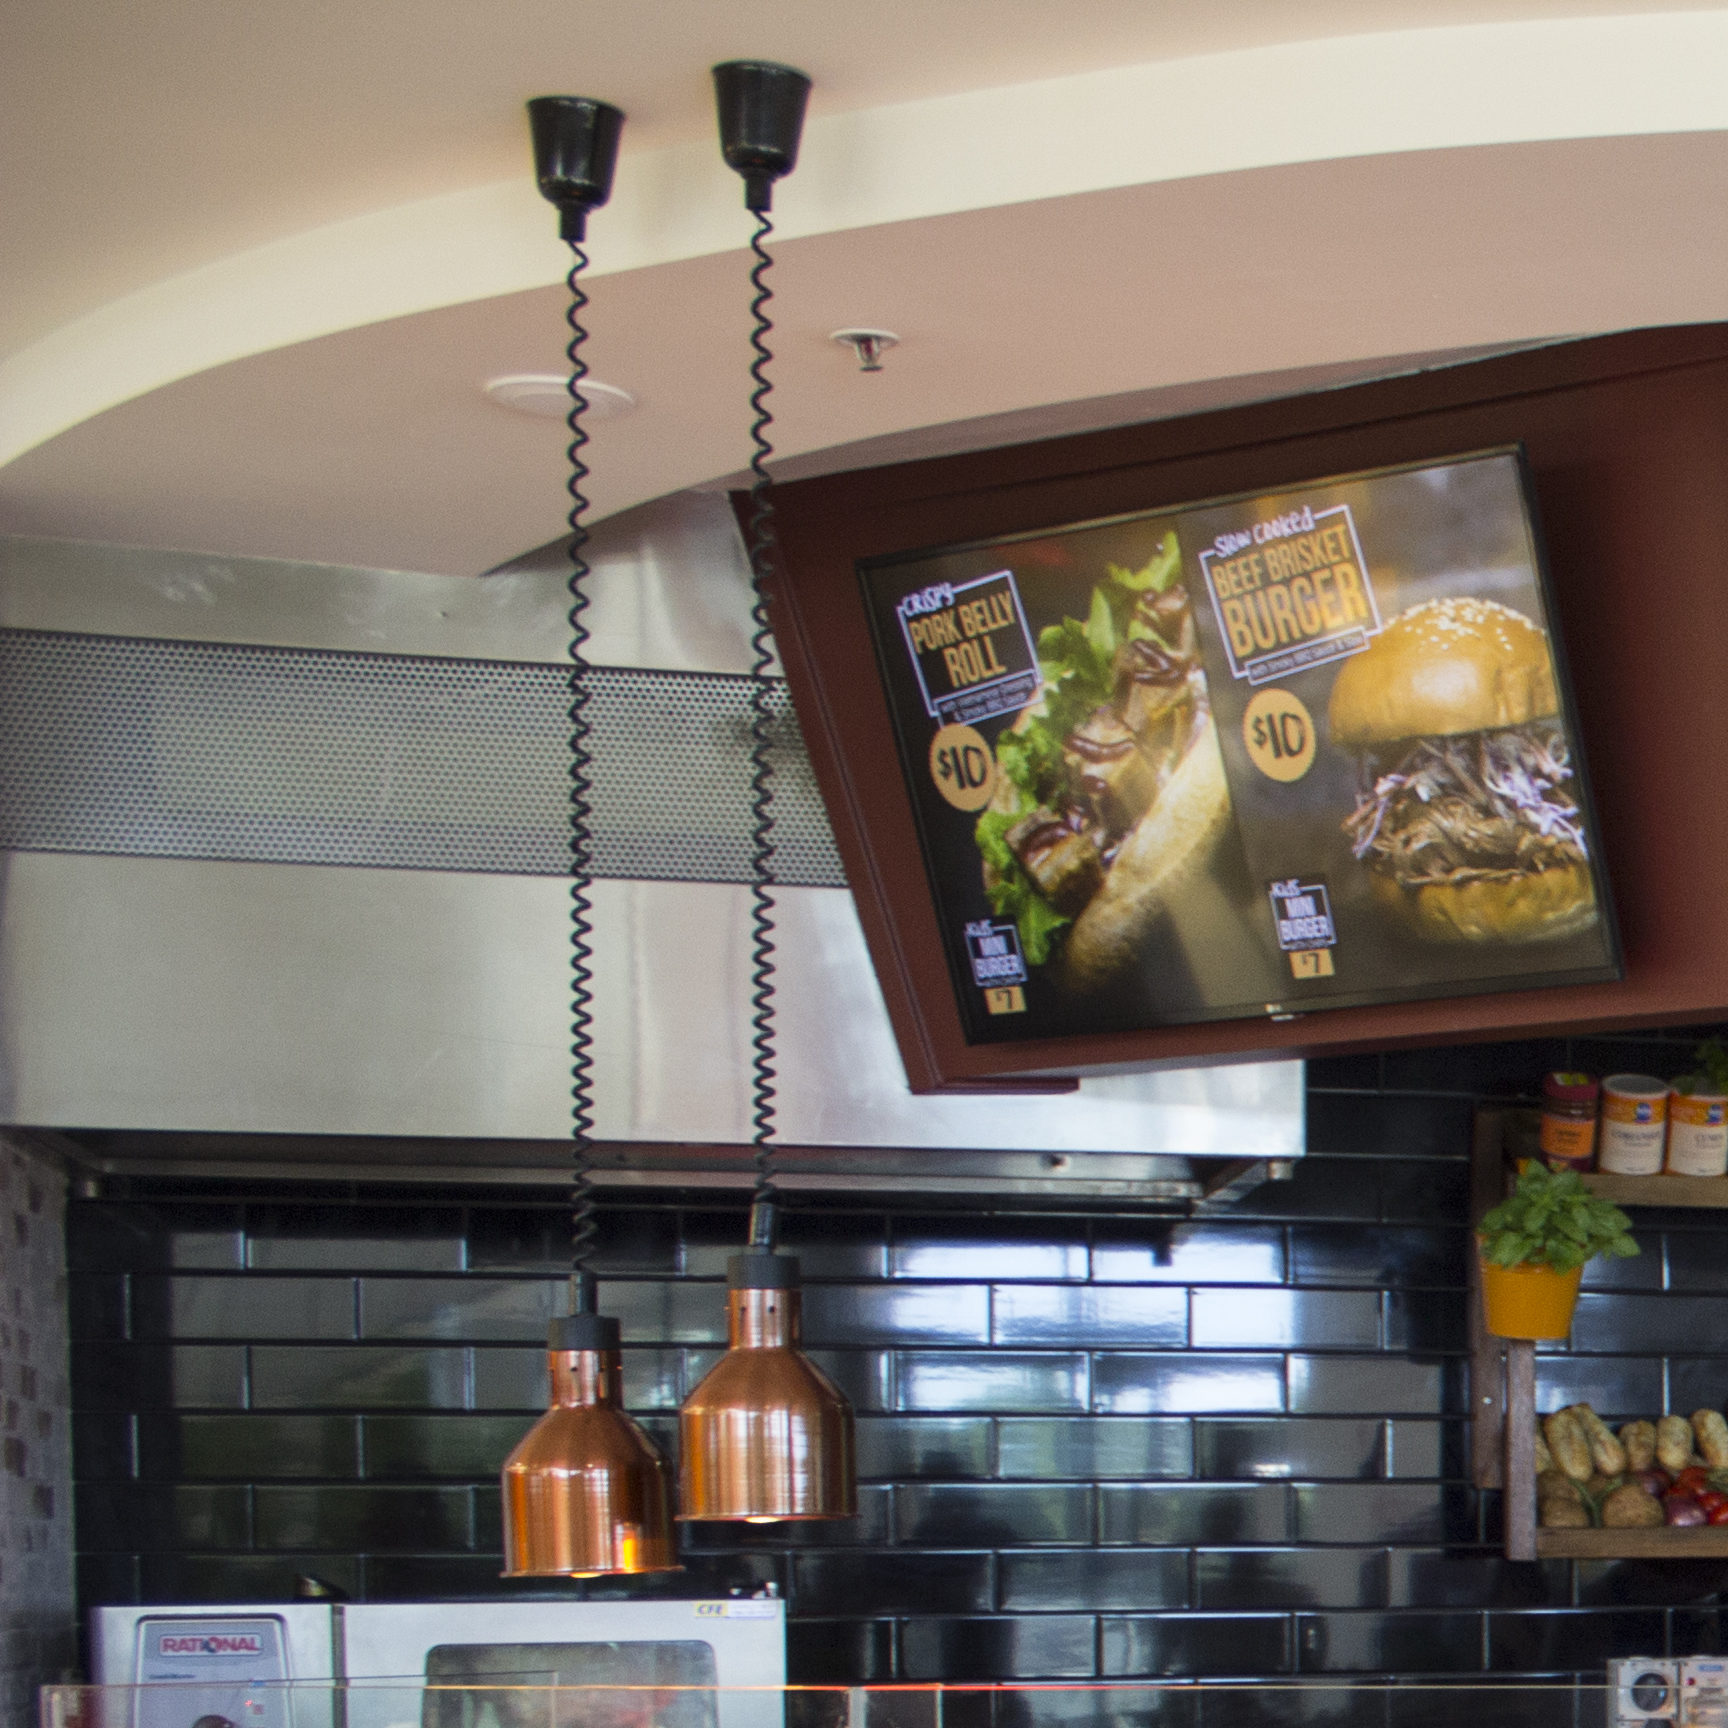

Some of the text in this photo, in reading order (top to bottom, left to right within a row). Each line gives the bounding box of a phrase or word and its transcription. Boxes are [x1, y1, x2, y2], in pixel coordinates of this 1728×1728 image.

[1211, 524, 1350, 599] BEEF BRISKET
[908, 591, 1016, 654] PORK BELLY
[1221, 562, 1368, 658] BURGER
[944, 635, 1008, 688] ROLL
[1253, 712, 1305, 759] $10
[937, 745, 987, 790] $10
[1280, 914, 1330, 941] BURGER
[975, 954, 1022, 978] BURGER
[161, 1636, 260, 1654] RATIONAL
